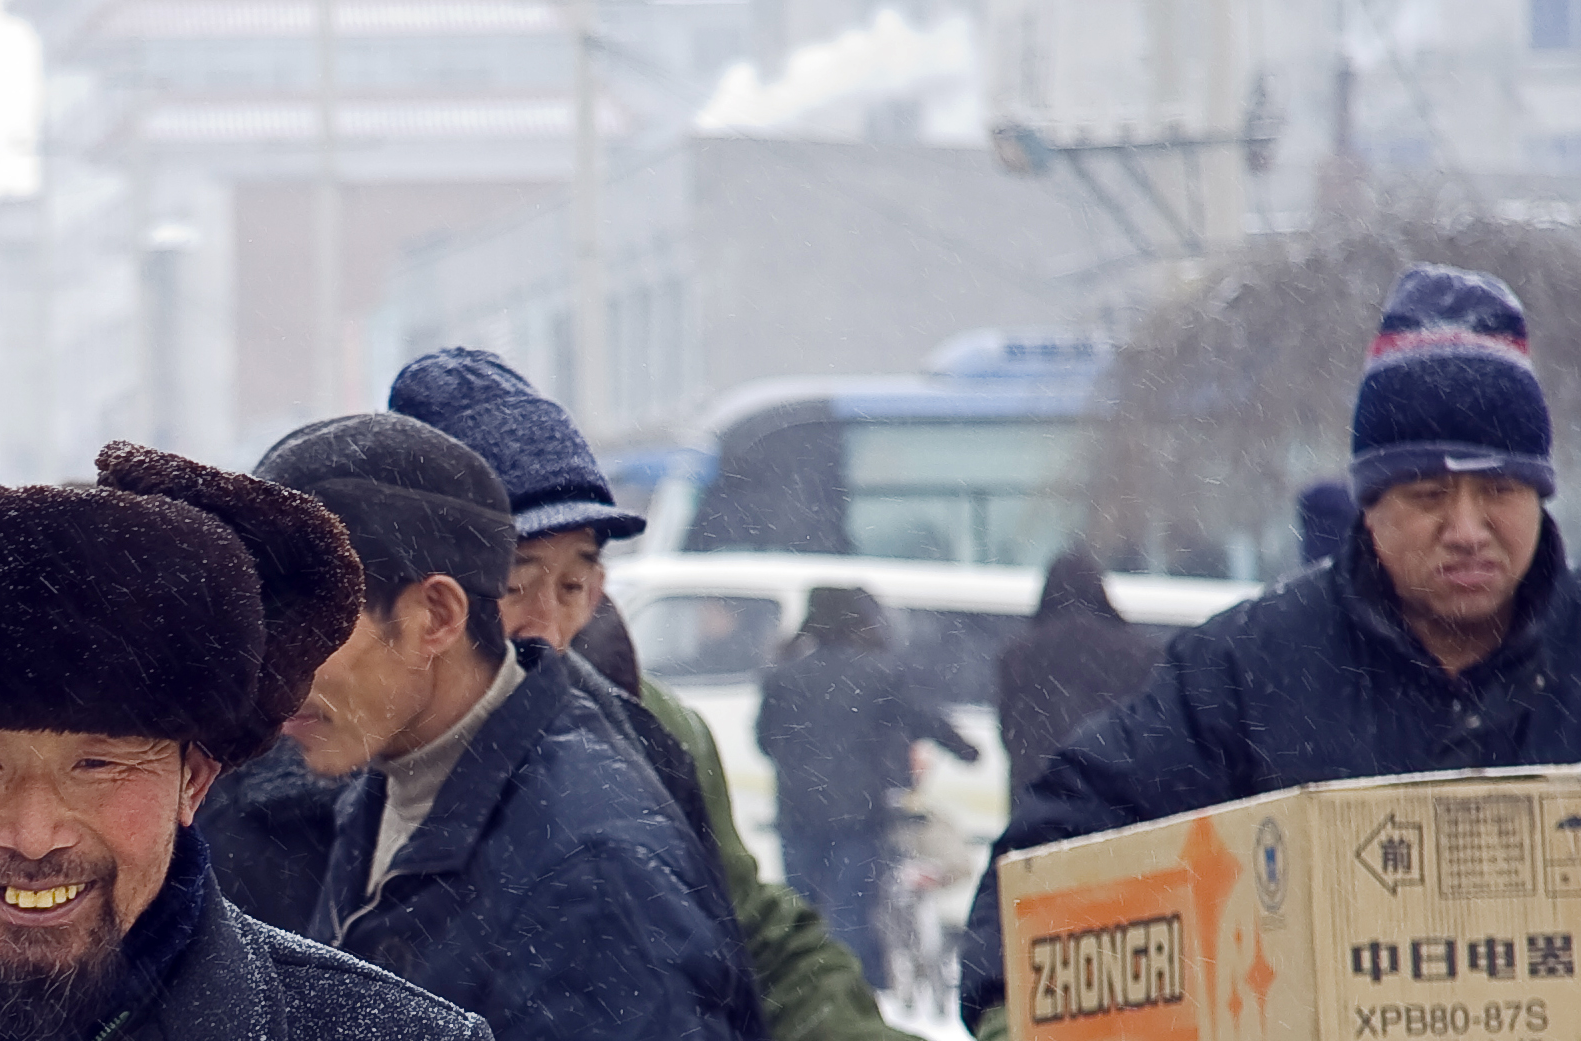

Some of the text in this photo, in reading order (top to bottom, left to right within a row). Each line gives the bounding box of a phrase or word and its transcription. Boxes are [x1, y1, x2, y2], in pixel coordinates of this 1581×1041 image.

[1382, 836, 1412, 874] 前
[1029, 911, 1184, 1026] ZHONGRI
[1352, 933, 1575, 983] 中日电器
[1355, 997, 1549, 1039] XPB80-87S
